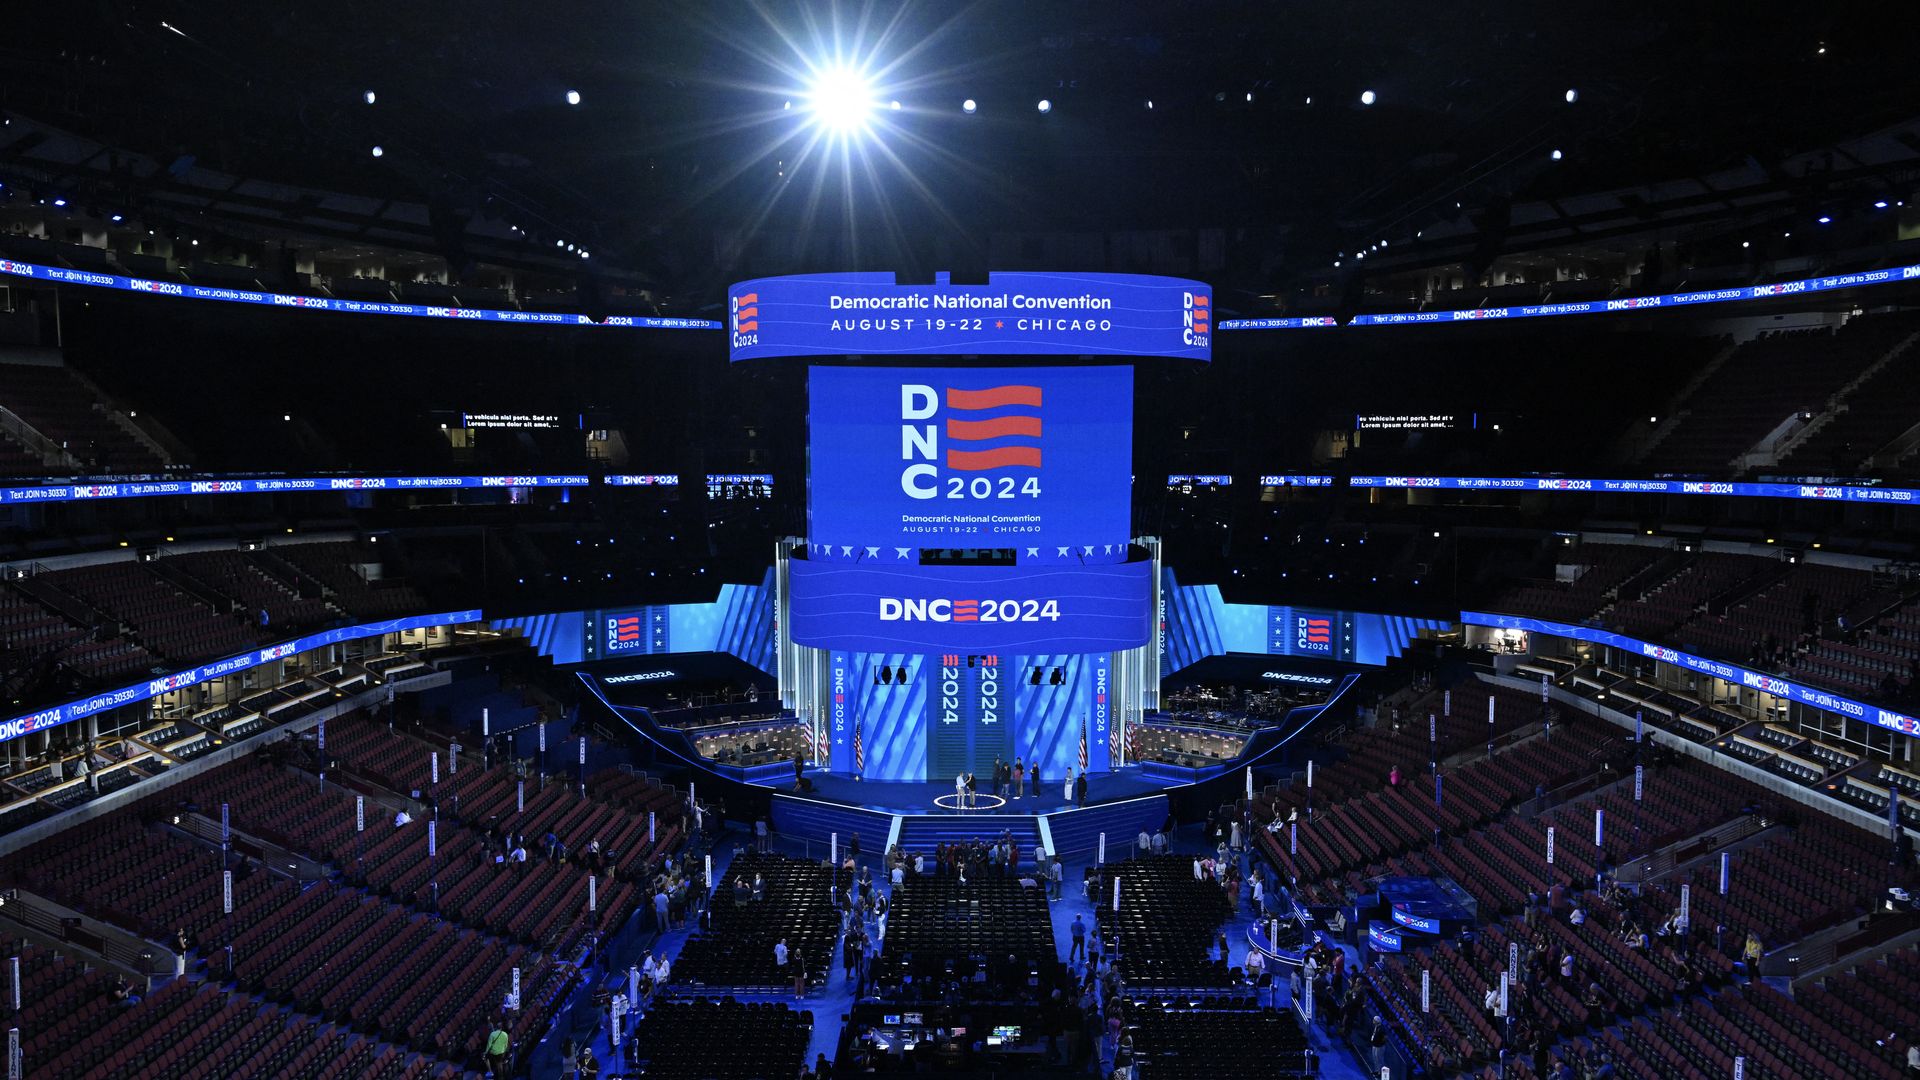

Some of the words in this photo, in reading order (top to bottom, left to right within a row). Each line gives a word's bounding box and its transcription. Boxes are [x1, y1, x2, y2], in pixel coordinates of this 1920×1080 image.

[1823, 278, 1837, 286] Text
[1838, 276, 1855, 284] JOIN
[1865, 272, 1888, 281] 30330
[194, 288, 210, 297] Text
[211, 290, 230, 298] JOIN
[231, 291, 239, 299] to
[240, 292, 262, 301] 30330
[1673, 295, 1688, 303] Text
[1689, 293, 1707, 301] JOIN
[1708, 292, 1715, 300] to
[1717, 290, 1740, 299] 30330
[830, 295, 929, 310] Democratic
[933, 294, 1008, 310] National
[1012, 294, 1111, 310] Convention
[831, 319, 914, 331] AUGUST
[925, 319, 982, 331] 19-22
[1017, 319, 1111, 331] CHICAGO
[901, 384, 939, 500] DNC
[947, 477, 1042, 499] 2024
[10, 490, 24, 499] Text
[25, 489, 40, 498] JOIN
[41, 489, 47, 497] to
[48, 488, 67, 497] 30330
[1856, 489, 1868, 498] Text
[1869, 490, 1883, 499] JOIN
[1884, 491, 1890, 499] to
[1891, 491, 1911, 500] 30330
[902, 515, 951, 523] Democratic
[953, 515, 990, 523] National
[991, 515, 1040, 523] Convention
[203, 667, 214, 677] Text
[215, 663, 227, 673] JOIN
[228, 662, 233, 670] to
[234, 657, 250, 668] 30330
[1687, 656, 1697, 666] Text
[1698, 660, 1710, 671] JOIN
[1711, 663, 1716, 672] to
[1717, 665, 1733, 678] 30330
[72, 705, 87, 716] Text
[87, 699, 104, 711] JOIN
[105, 697, 112, 706] to
[114, 690, 134, 703] 30330
[1801, 690, 1815, 702] Text
[1816, 694, 1832, 707] JOIN
[1833, 699, 1840, 709] to
[1841, 701, 1863, 717] 30330
